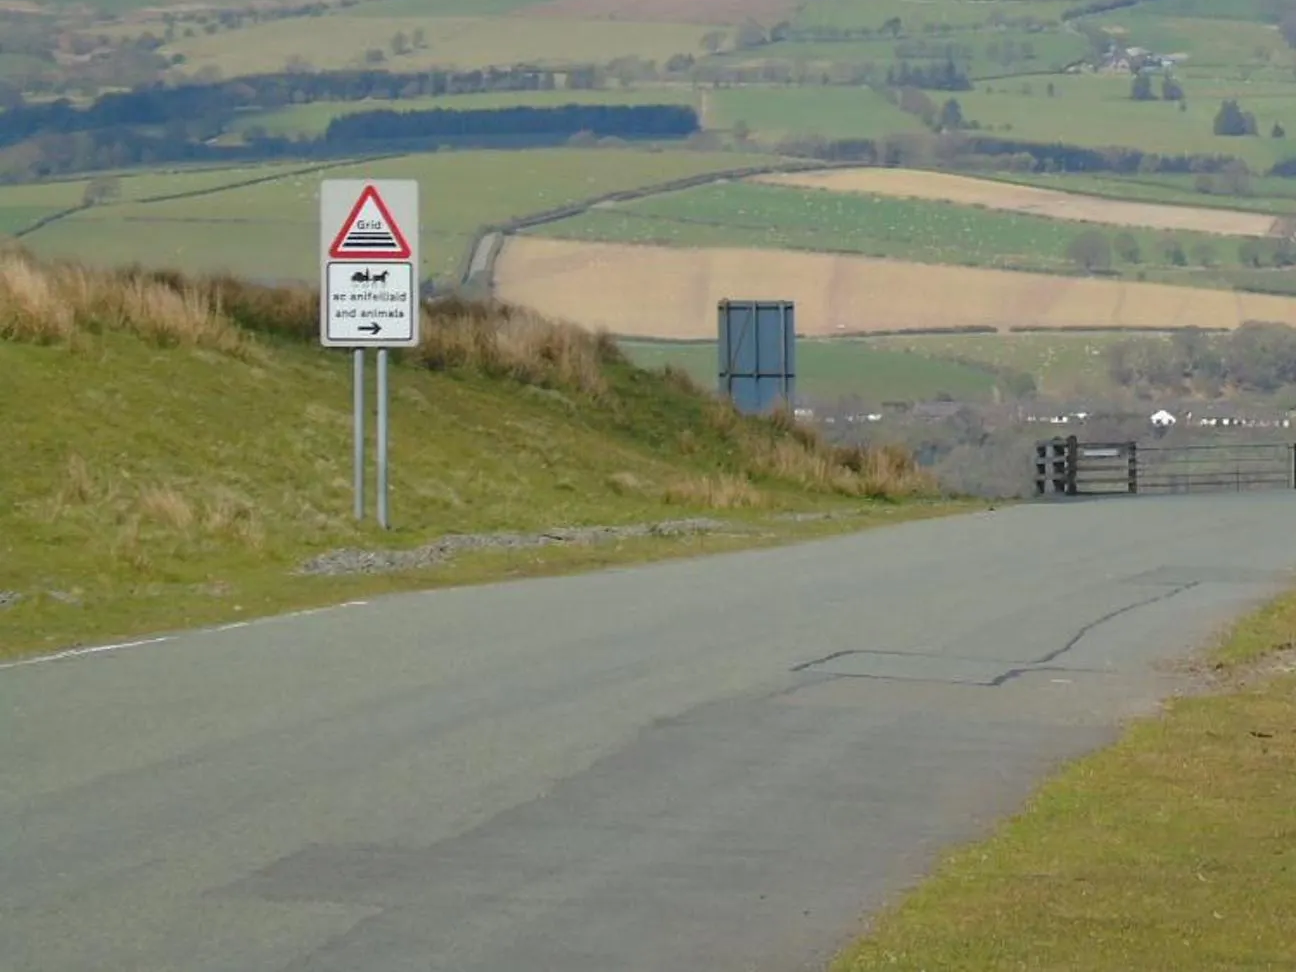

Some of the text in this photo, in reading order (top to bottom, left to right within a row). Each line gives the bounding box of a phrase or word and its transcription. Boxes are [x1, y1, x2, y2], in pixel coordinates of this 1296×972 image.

[357, 219, 381, 229] Grid
[336, 309, 404, 318] and animals
